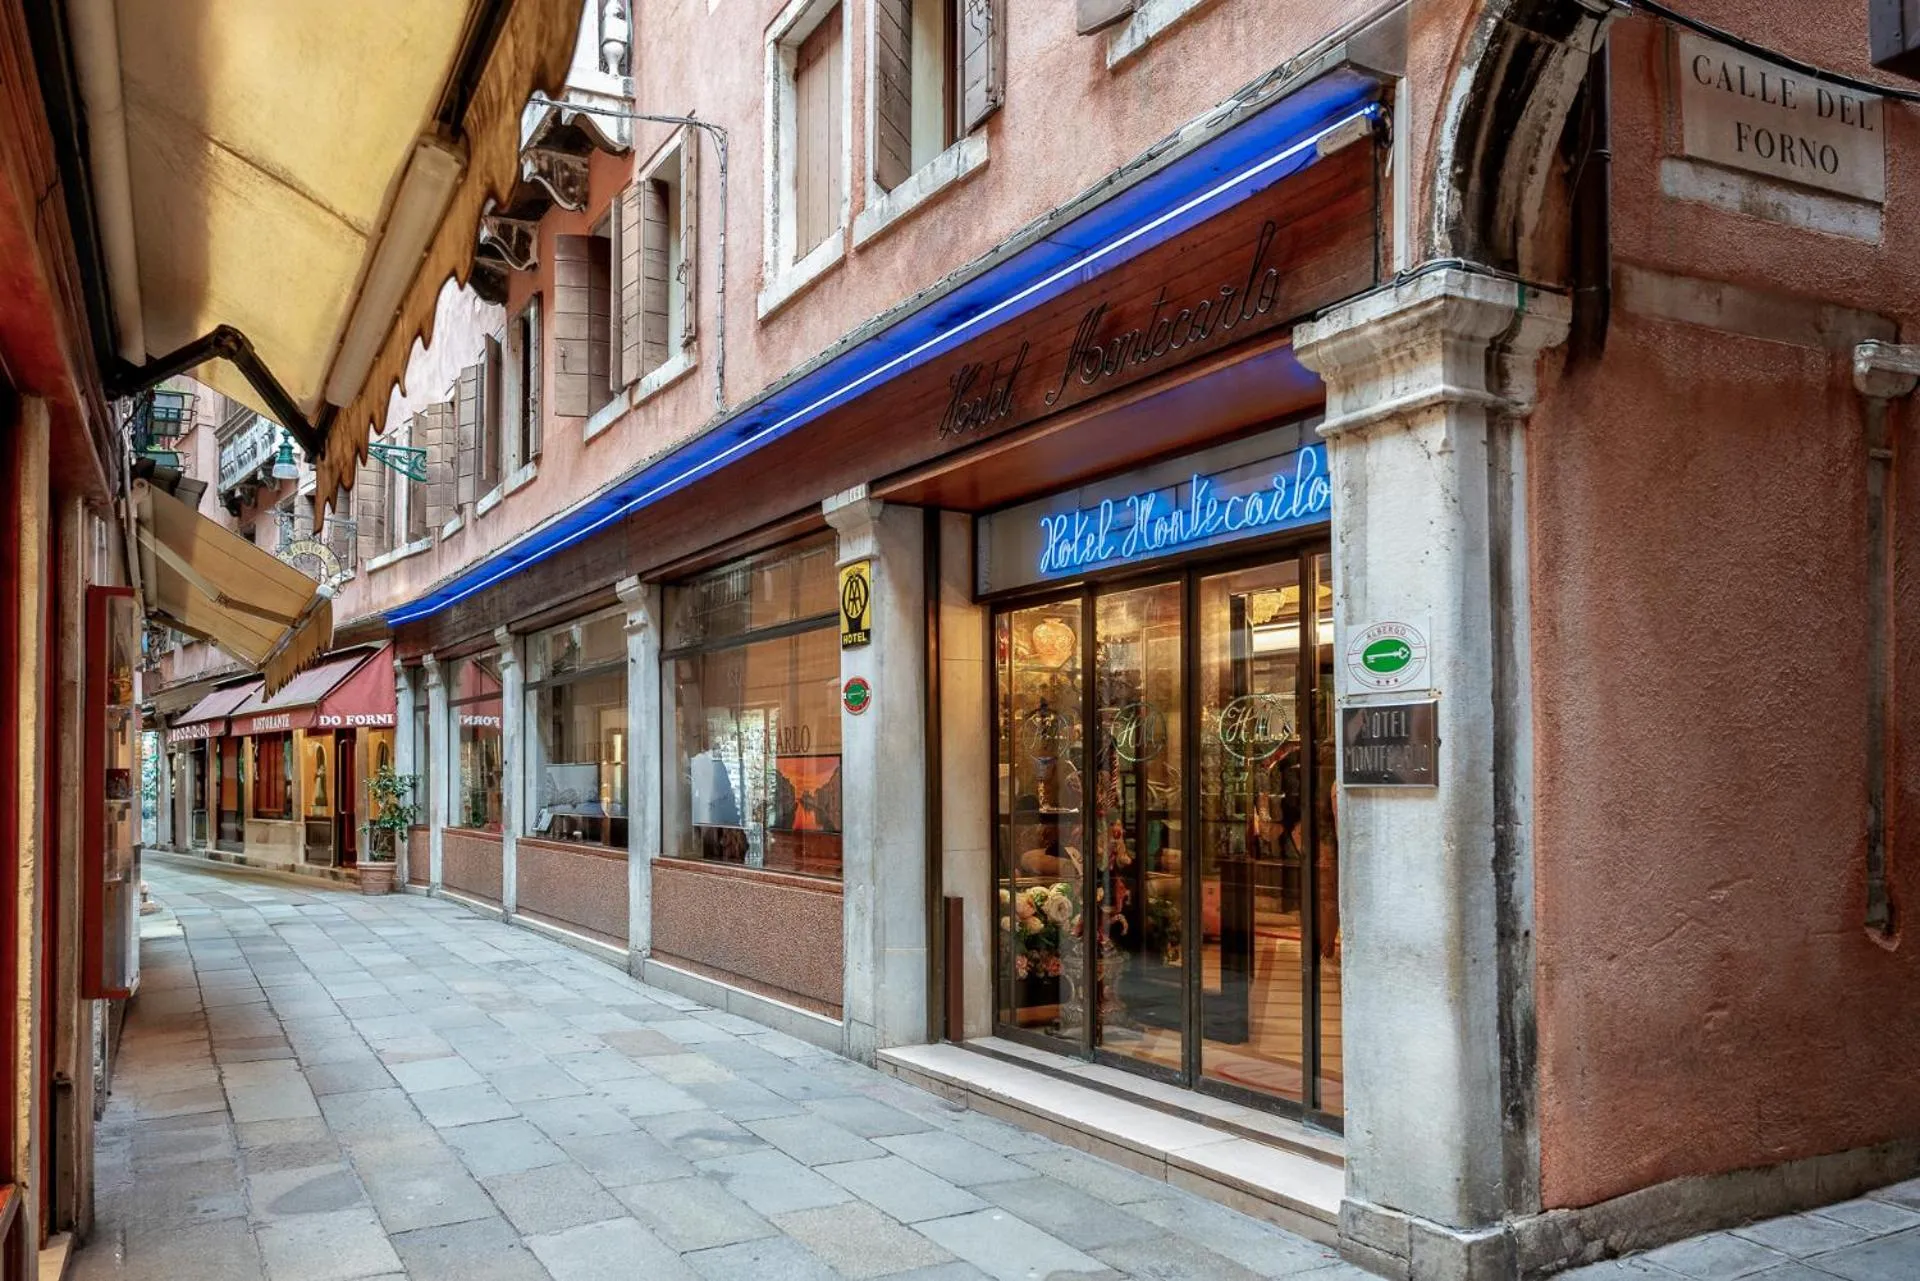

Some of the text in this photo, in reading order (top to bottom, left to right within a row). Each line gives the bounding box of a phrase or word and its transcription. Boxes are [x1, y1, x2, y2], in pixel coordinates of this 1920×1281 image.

[1693, 54, 1874, 132] CALLE DEL
[1736, 122, 1839, 175] FORNO
[938, 221, 1281, 440] Hotel Montecarlo
[1040, 446, 1332, 574] Hotel Montecarlo
[843, 631, 867, 645] HOTEL
[1366, 624, 1407, 639] ALBERGO
[319, 713, 394, 726] DO FORNI
[1361, 711, 1409, 739] HOTEL
